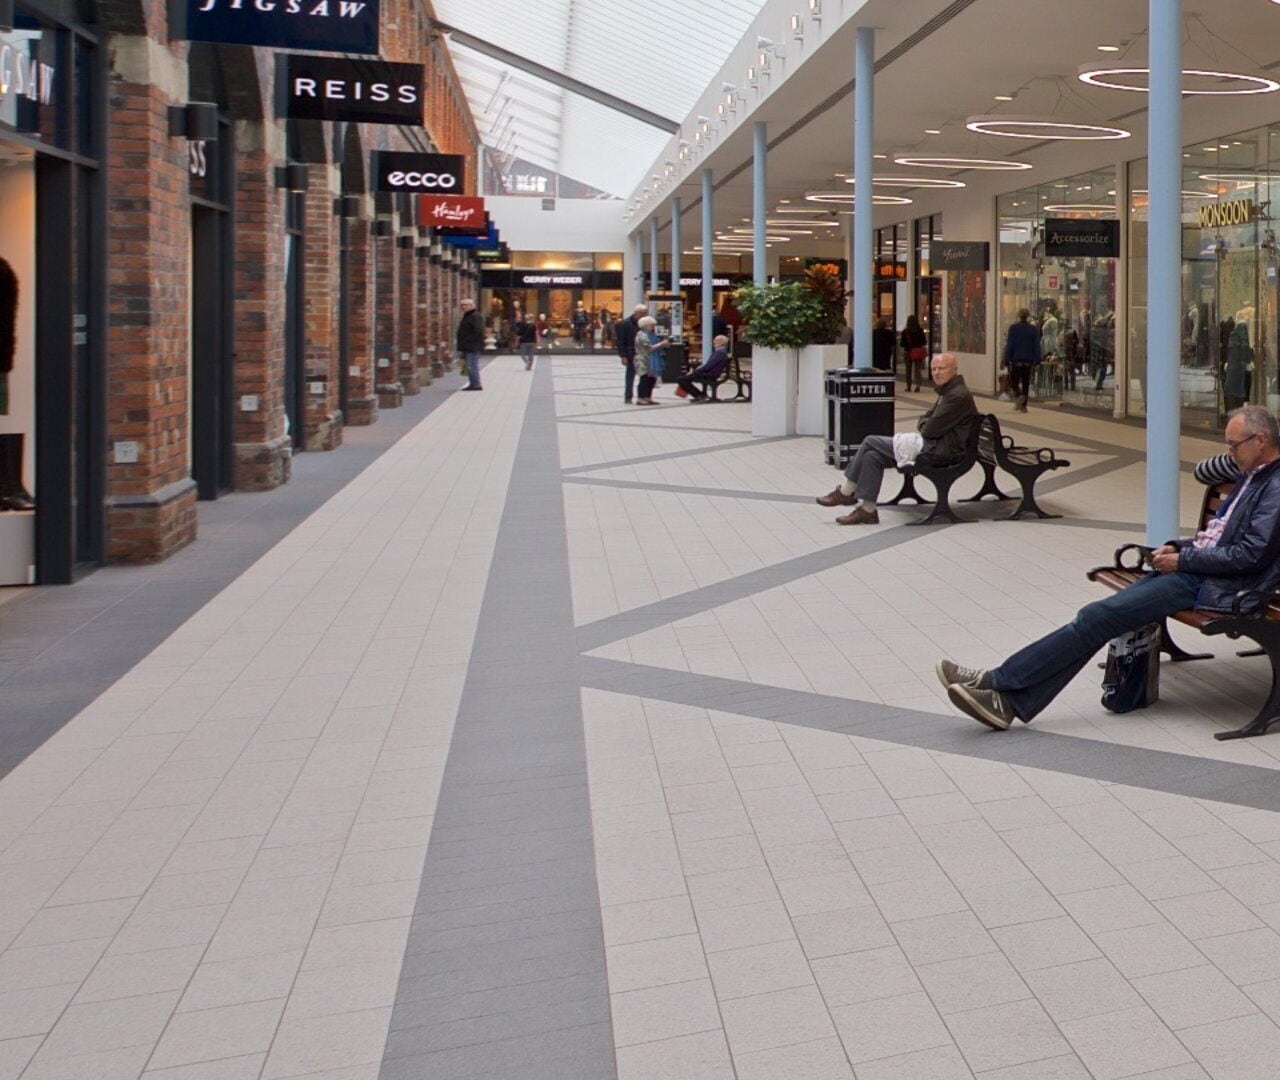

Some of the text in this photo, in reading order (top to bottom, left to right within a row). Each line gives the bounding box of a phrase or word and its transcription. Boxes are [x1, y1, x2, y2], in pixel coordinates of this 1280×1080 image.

[294, 77, 417, 104] REISS
[387, 171, 456, 188] ecco
[1200, 199, 1248, 228] MONSOON
[1051, 232, 1110, 245] Accessorize
[523, 275, 583, 284] GERRY WEBER
[850, 384, 887, 396] LITTER
